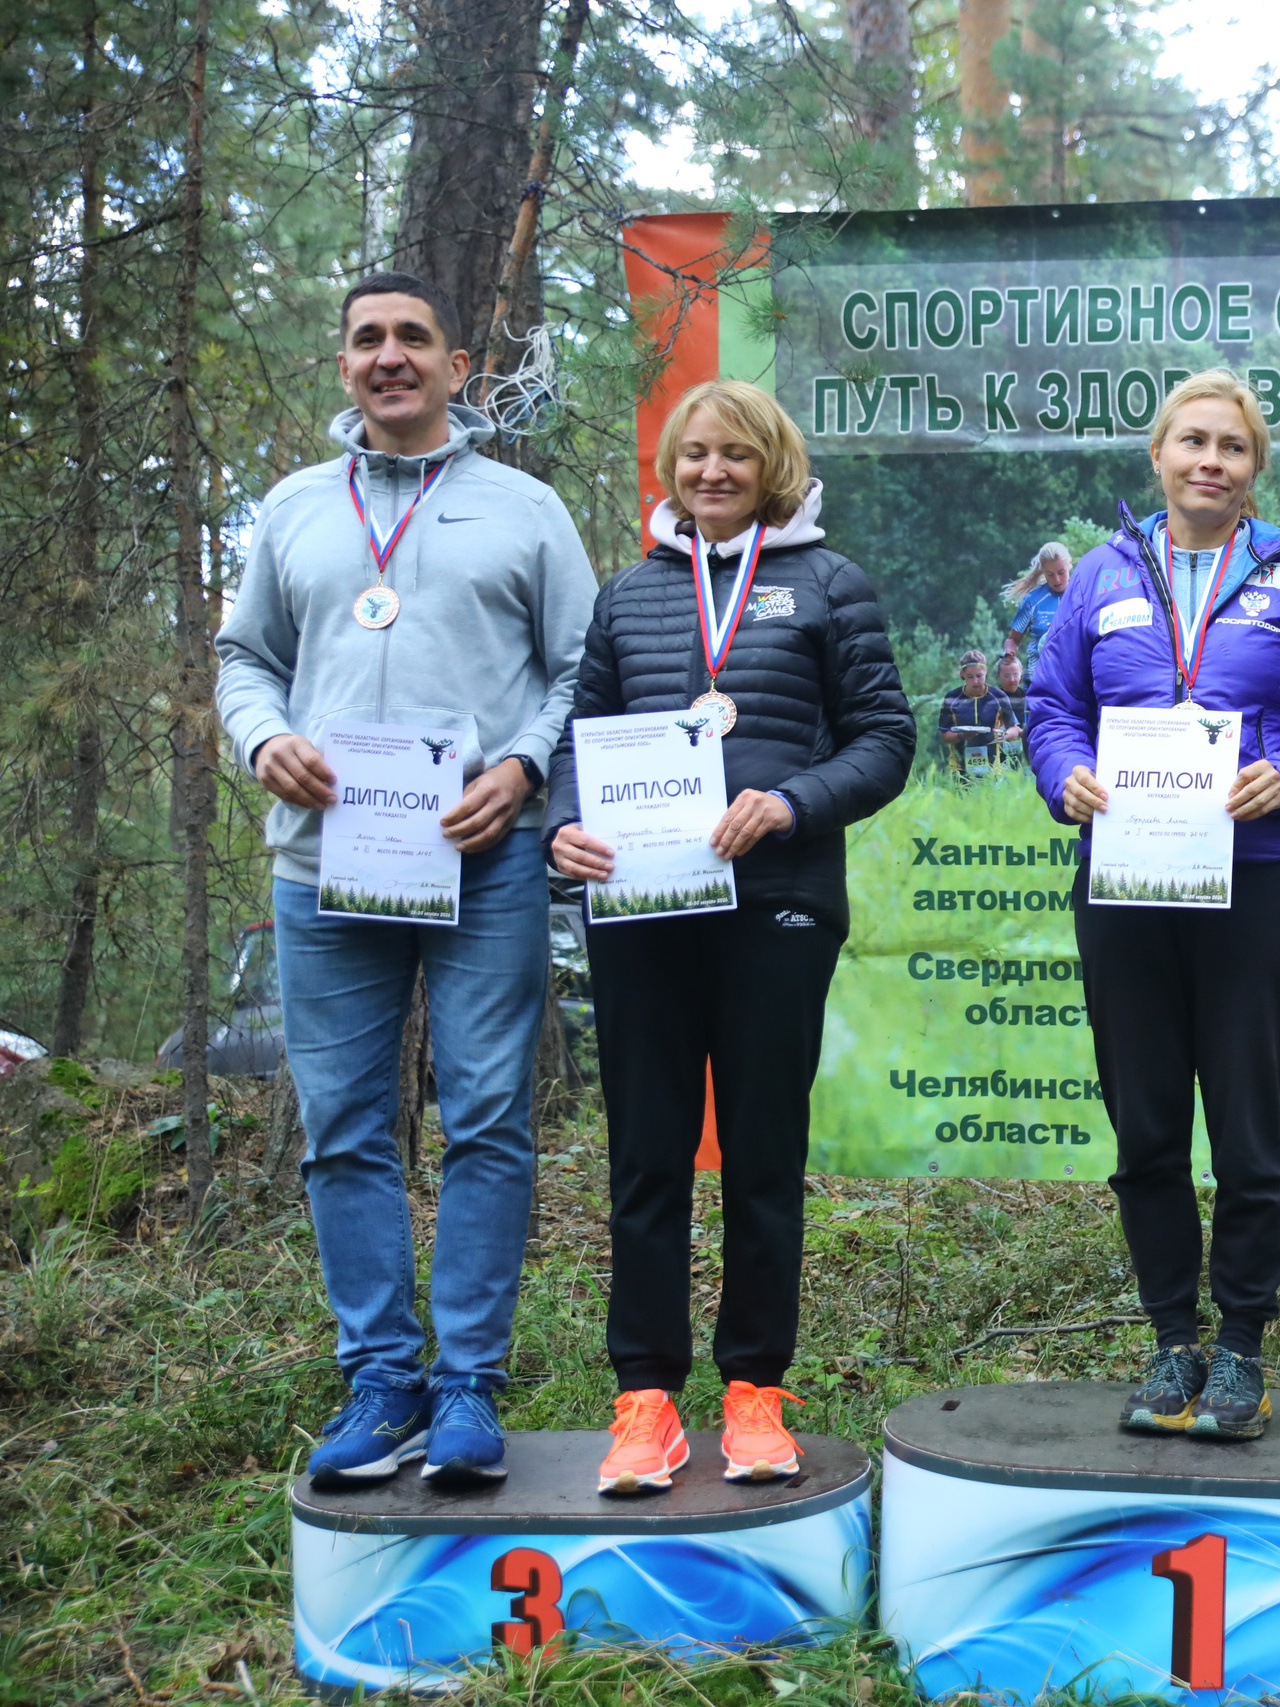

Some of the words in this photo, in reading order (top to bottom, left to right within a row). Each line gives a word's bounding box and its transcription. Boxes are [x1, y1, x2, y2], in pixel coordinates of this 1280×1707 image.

[842, 283, 1252, 350] СПОРТИВНОЕ
[814, 373, 963, 434] ПУТЬ
[984, 371, 1019, 432] К
[1215, 617, 1280, 634] РОСАВТОДОР
[601, 777, 701, 804] ДИПЛОМ
[1115, 771, 1213, 789] ДИПЛОМ
[343, 787, 439, 811] ДИПЛОМ
[935, 1114, 1091, 1145] область
[490, 1547, 566, 1666] 3
[1151, 1531, 1228, 1690] 1
